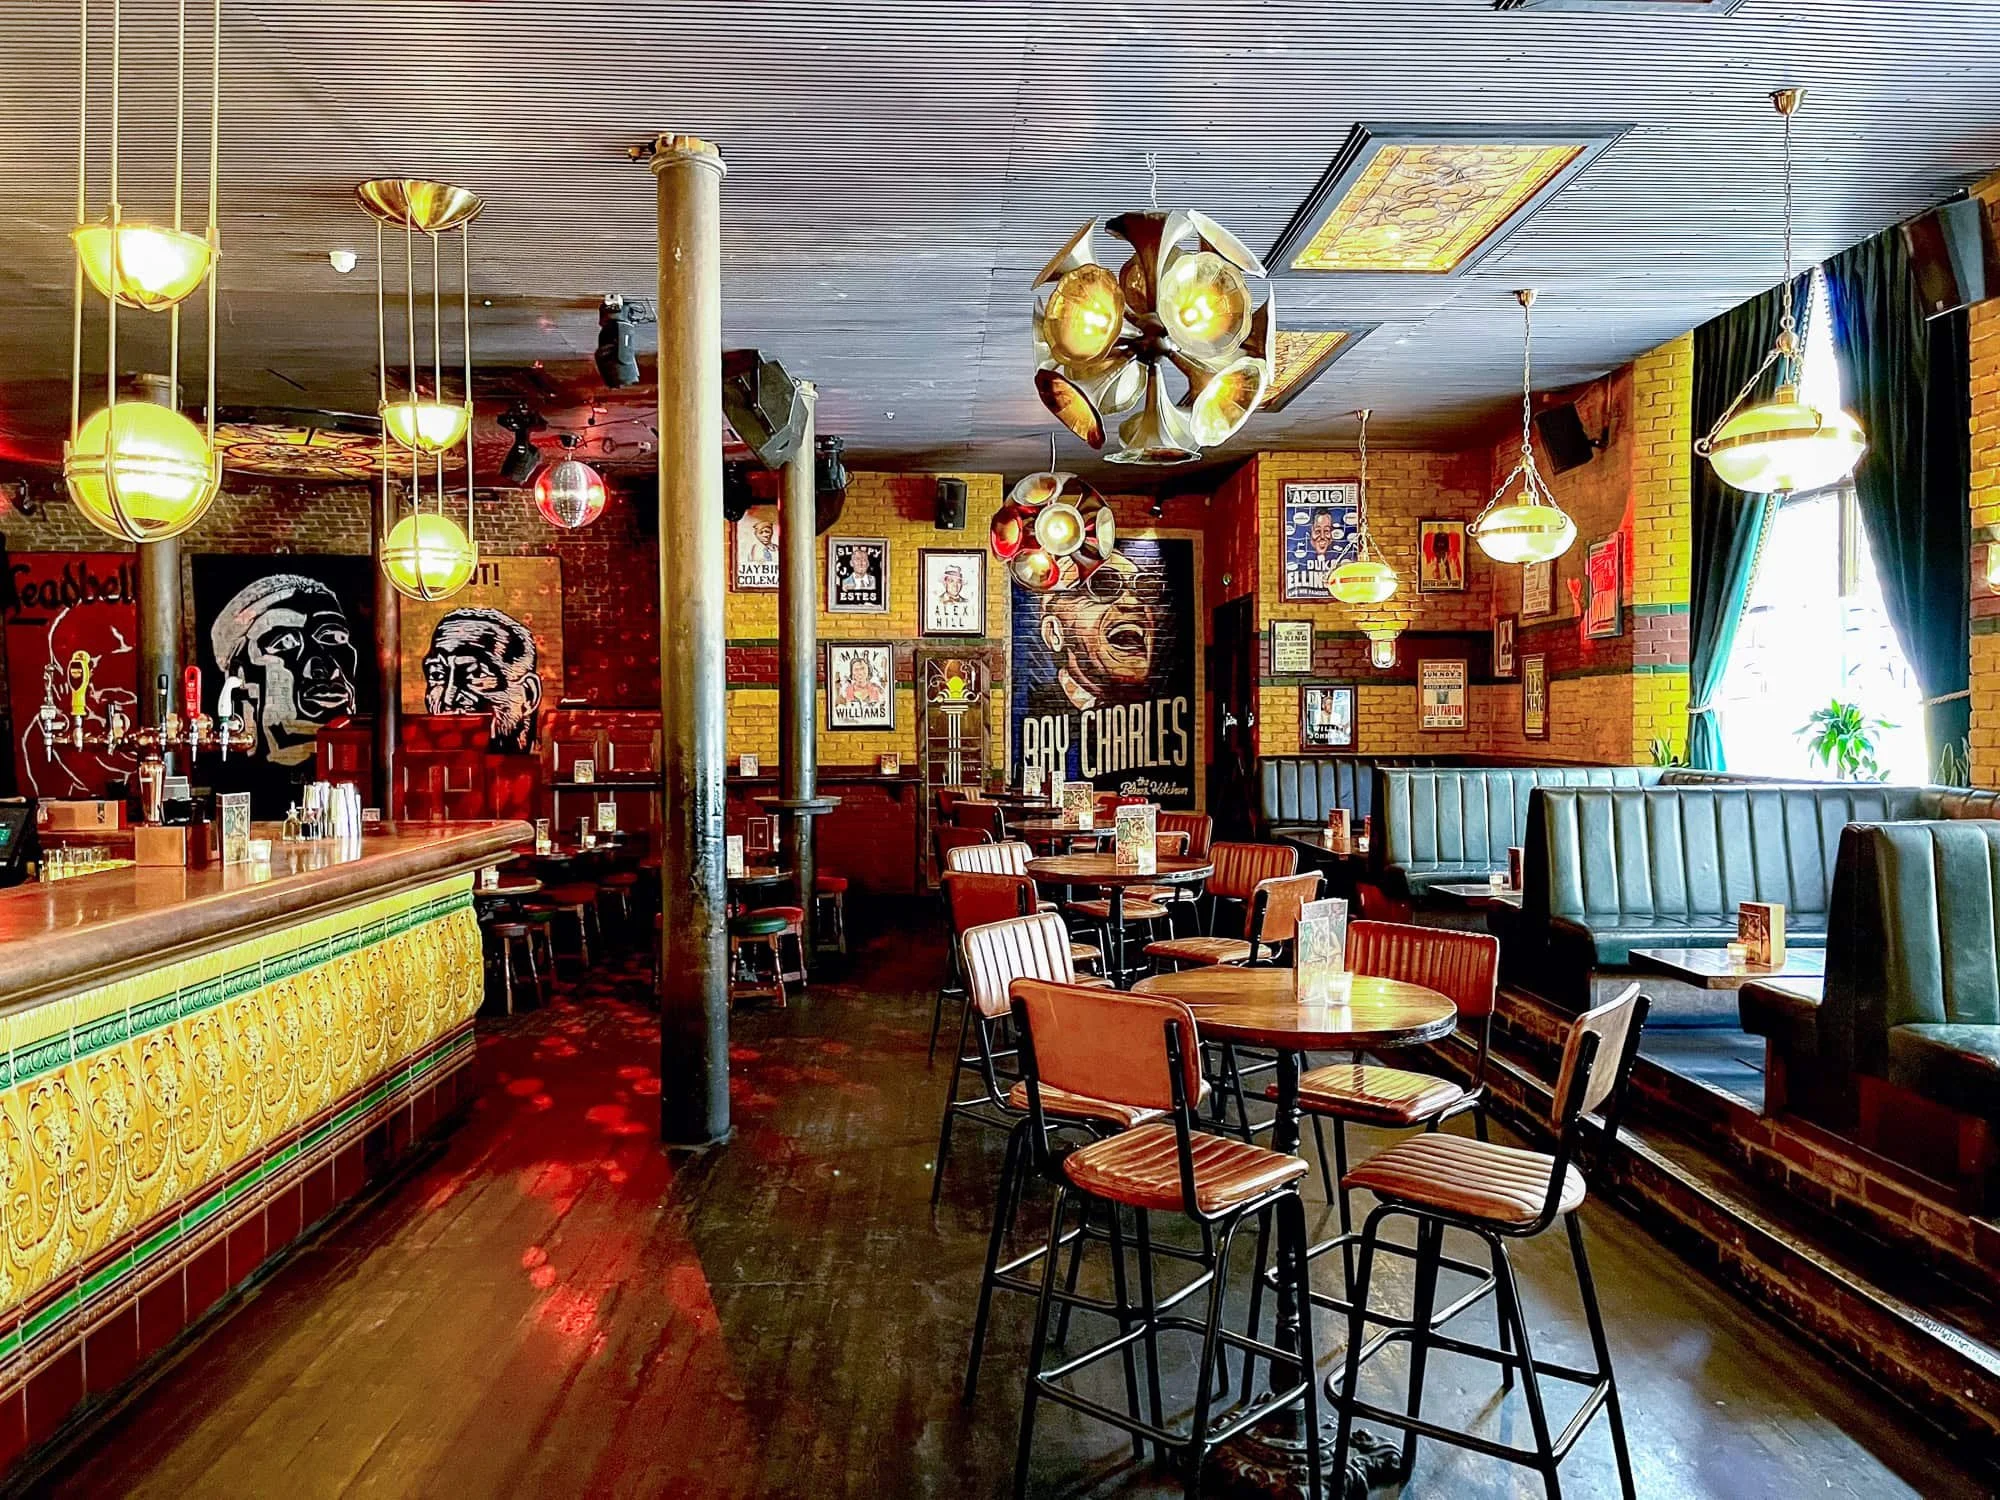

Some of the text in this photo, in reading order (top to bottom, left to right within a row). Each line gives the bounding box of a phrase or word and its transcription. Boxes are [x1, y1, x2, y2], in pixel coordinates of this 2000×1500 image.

[1292, 489, 1343, 503] APOLLO
[739, 564, 779, 575] JAYBI
[737, 575, 779, 585] COLEM
[839, 592, 877, 601] ESTES
[936, 617, 965, 627] HILL
[840, 649, 879, 662] MARY
[835, 708, 886, 718] WILLIAMS
[1023, 696, 1188, 782] RAY CHARLES
